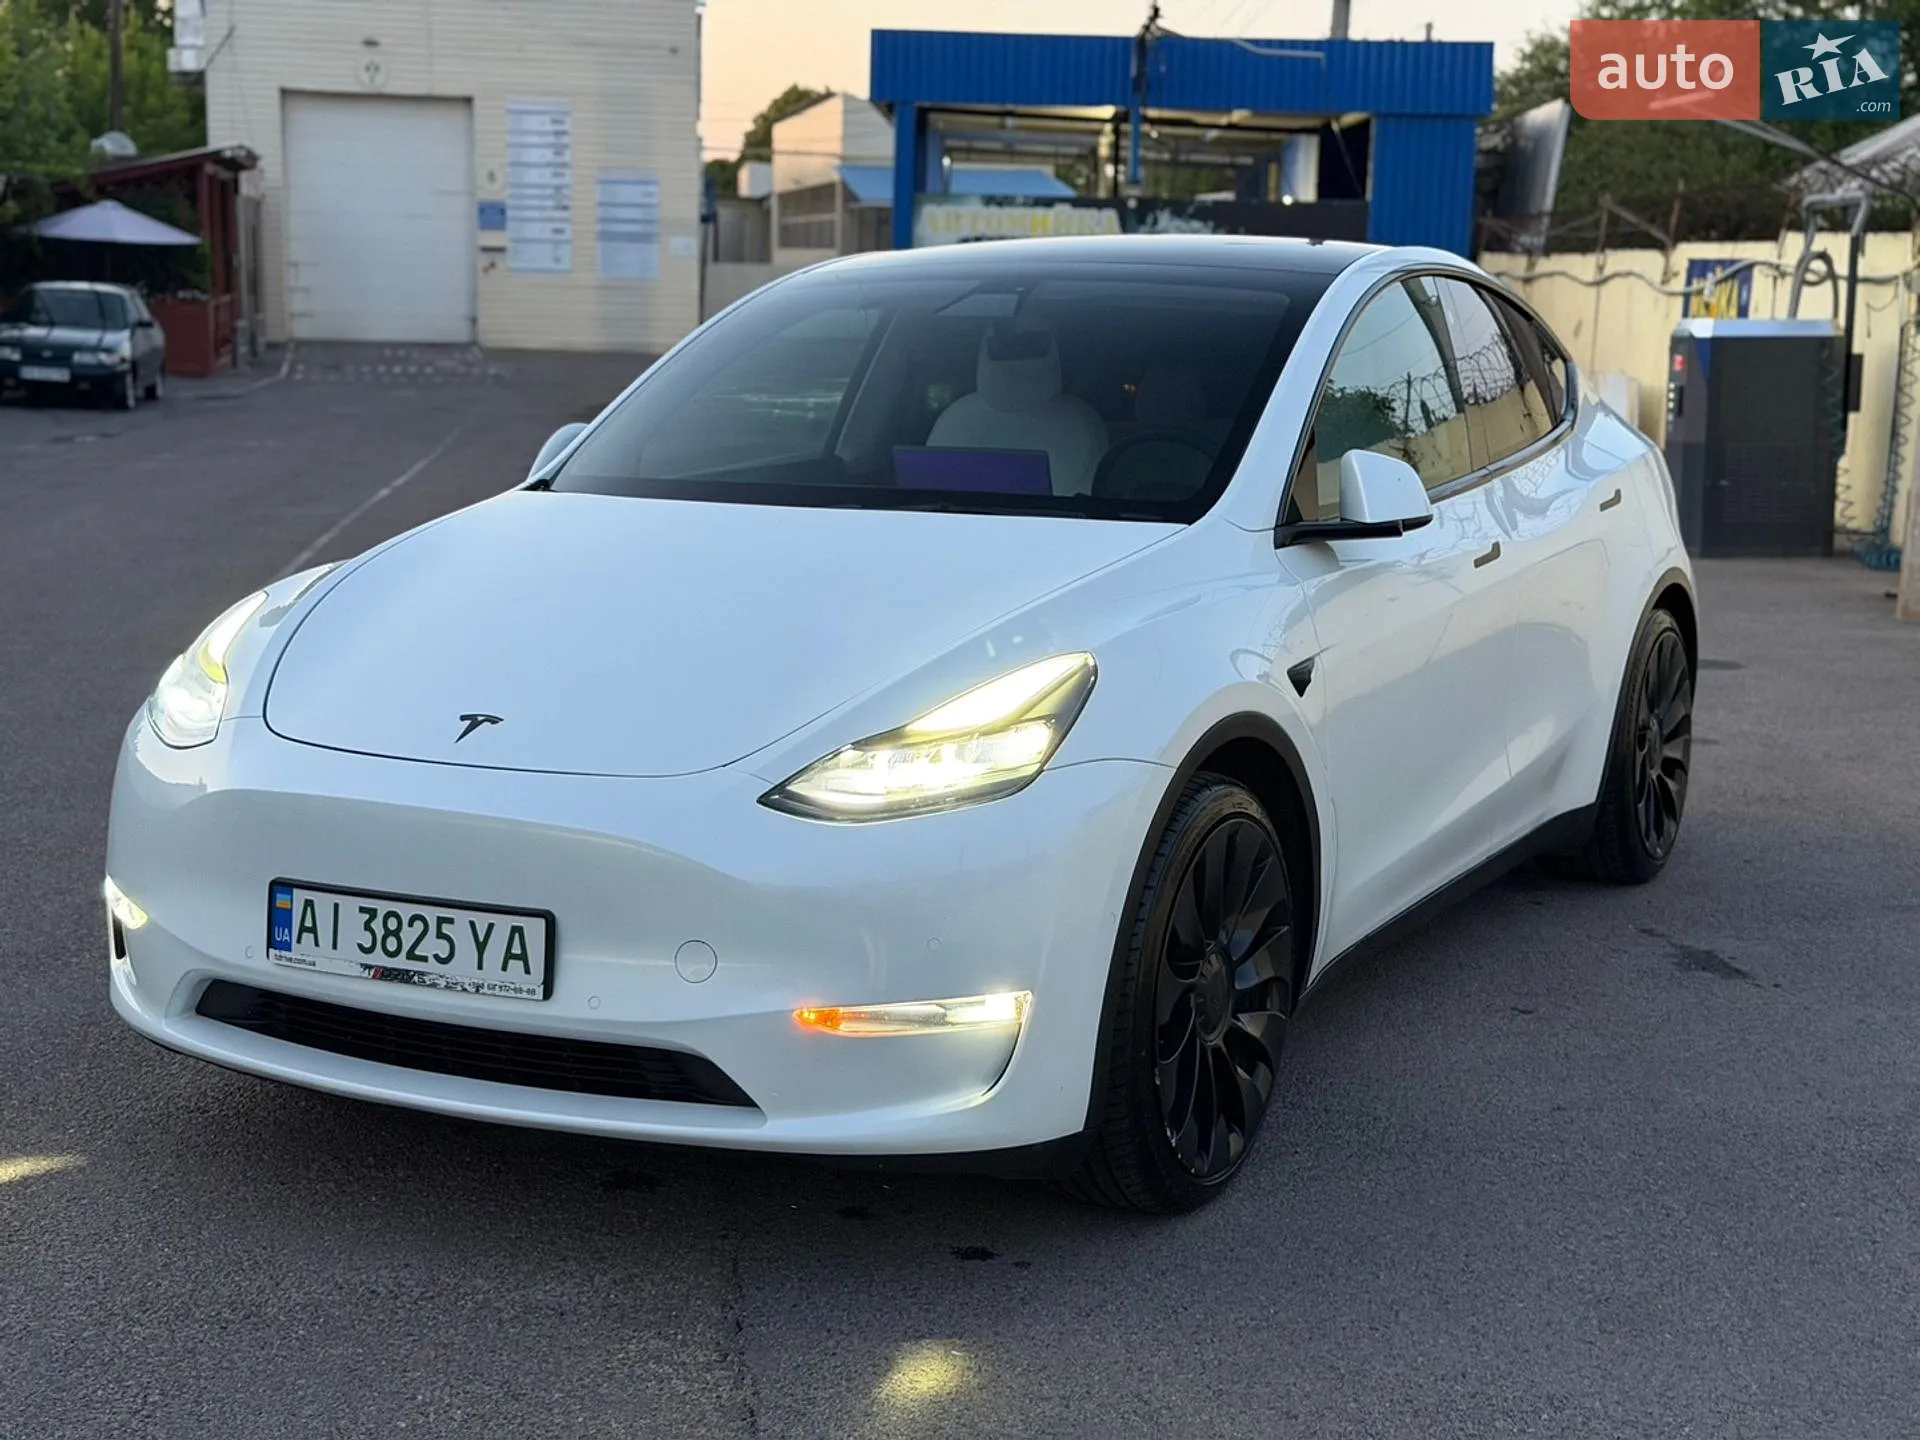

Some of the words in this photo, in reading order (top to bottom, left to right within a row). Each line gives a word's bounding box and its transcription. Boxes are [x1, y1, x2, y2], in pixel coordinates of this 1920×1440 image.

[274, 926, 291, 943] UA
[296, 898, 340, 950] AI
[356, 905, 456, 965] 3825
[468, 919, 531, 976] YA
